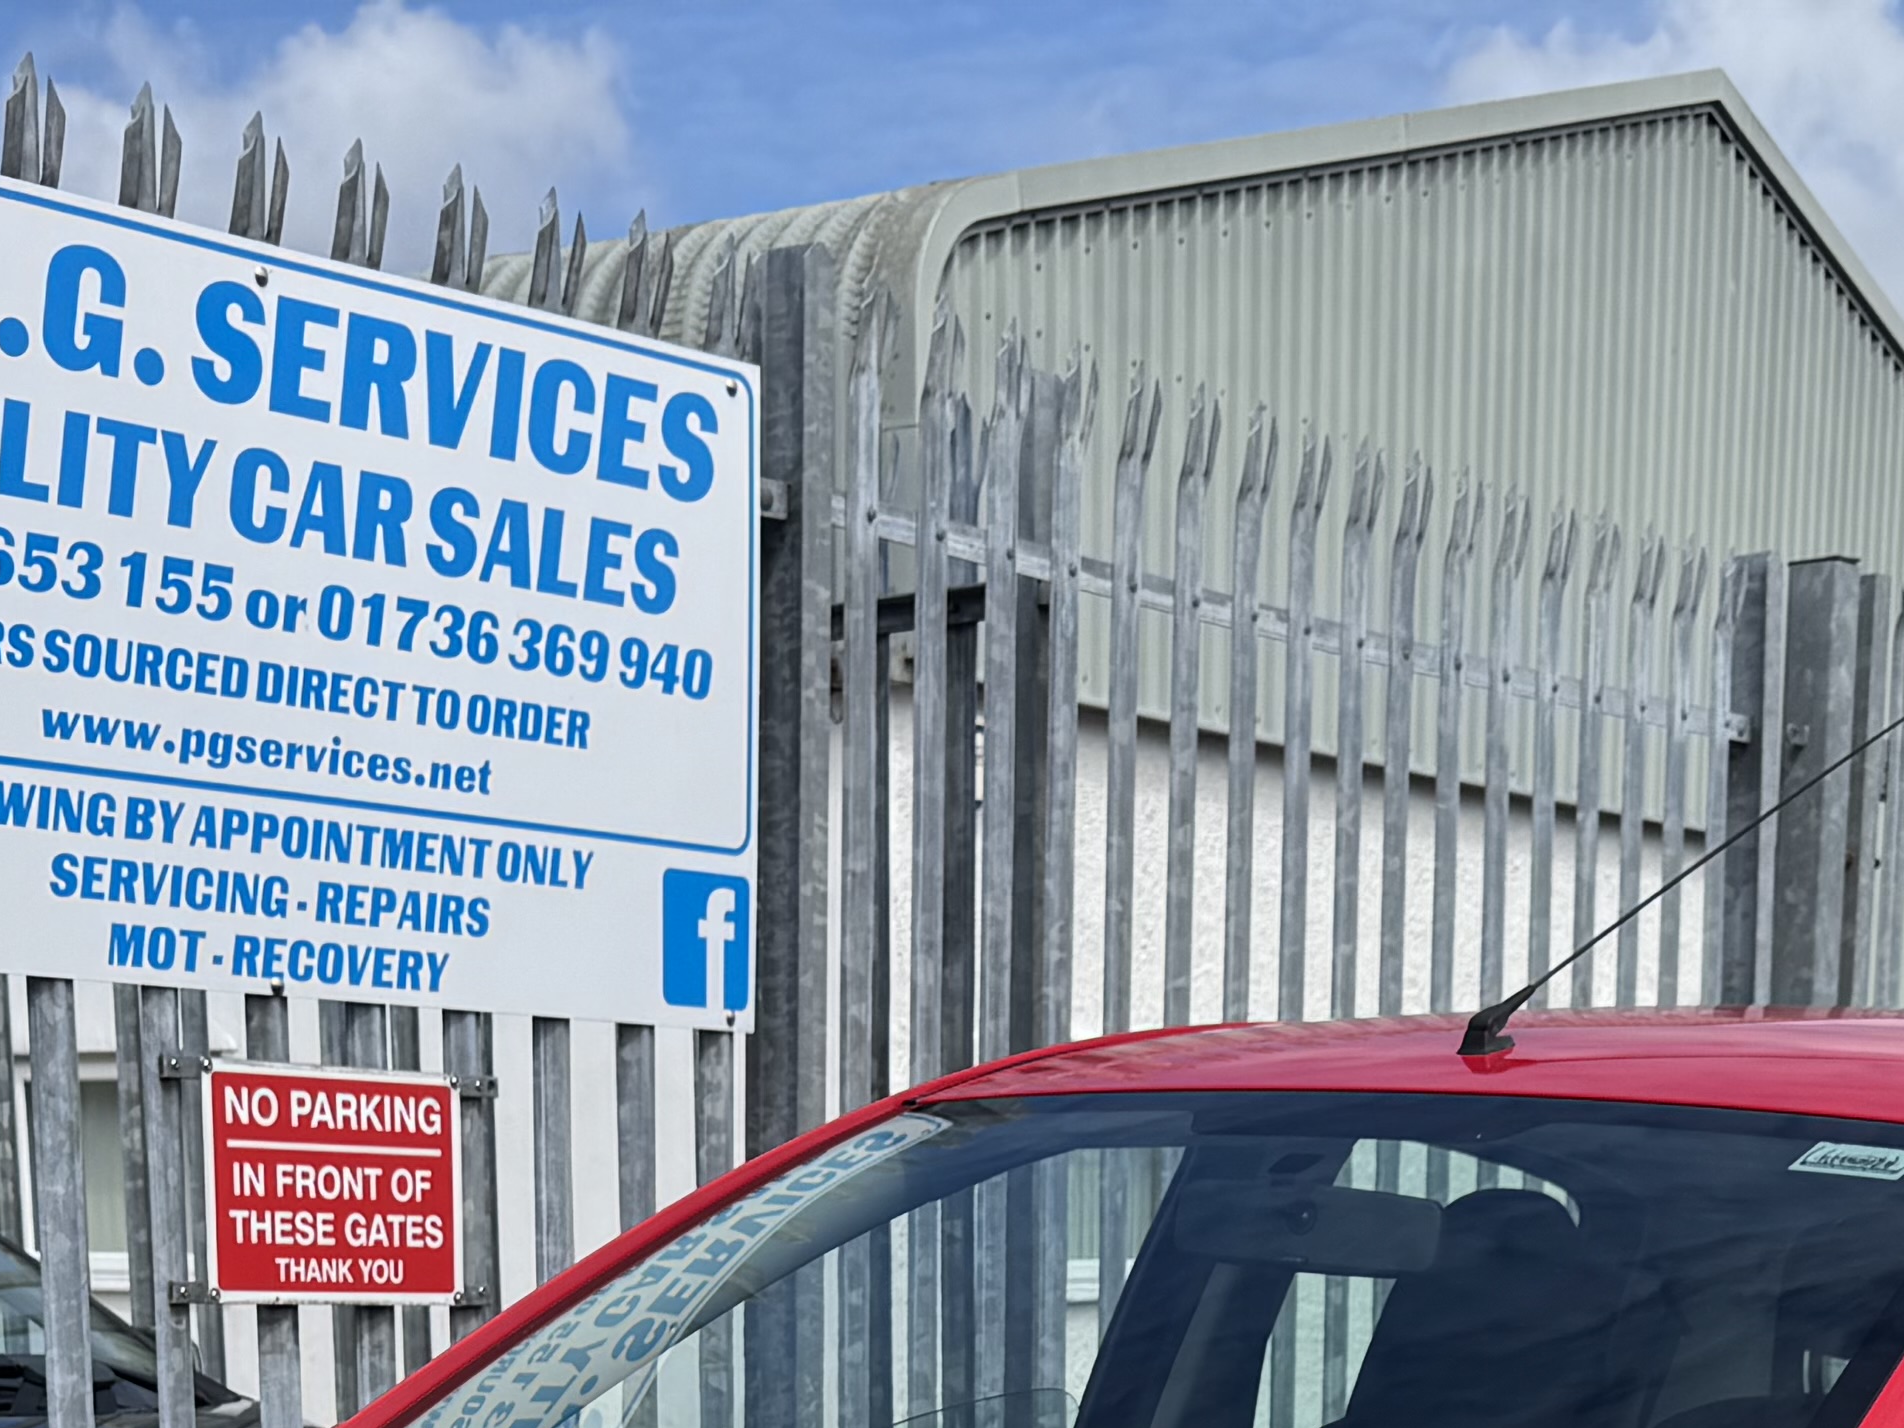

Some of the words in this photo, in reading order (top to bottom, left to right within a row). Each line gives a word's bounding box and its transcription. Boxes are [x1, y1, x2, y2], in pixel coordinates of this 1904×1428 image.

[190, 279, 720, 504] SERVICES
[228, 446, 413, 568] CAR
[425, 485, 681, 617] SALES
[120, 551, 234, 622] 155
[245, 588, 309, 634] or
[317, 583, 500, 665] 01736
[508, 617, 610, 683] 369
[619, 635, 713, 701] 940
[42, 628, 250, 699] SOURCED
[255, 661, 407, 722] DIRECT
[413, 685, 461, 731] TO
[466, 694, 591, 750] ORDER
[42, 708, 492, 797] www.pgservices.net
[124, 796, 185, 845] BY
[190, 805, 493, 879] APPOINTMENT
[497, 841, 593, 890] ONLY
[50, 853, 290, 919] SERVICING
[315, 881, 491, 938] REPAIRS
[108, 923, 207, 973] MOT
[232, 934, 449, 993] RECOVERY
[223, 1085, 279, 1127] NO
[289, 1089, 443, 1135] PARKING
[232, 1161, 265, 1198] IN
[275, 1163, 383, 1201] FRONT
[390, 1168, 433, 1203] OF
[228, 1209, 336, 1247] THESE
[344, 1212, 444, 1250] GATES
[274, 1257, 353, 1284] THANK
[357, 1258, 404, 1284] YOU
